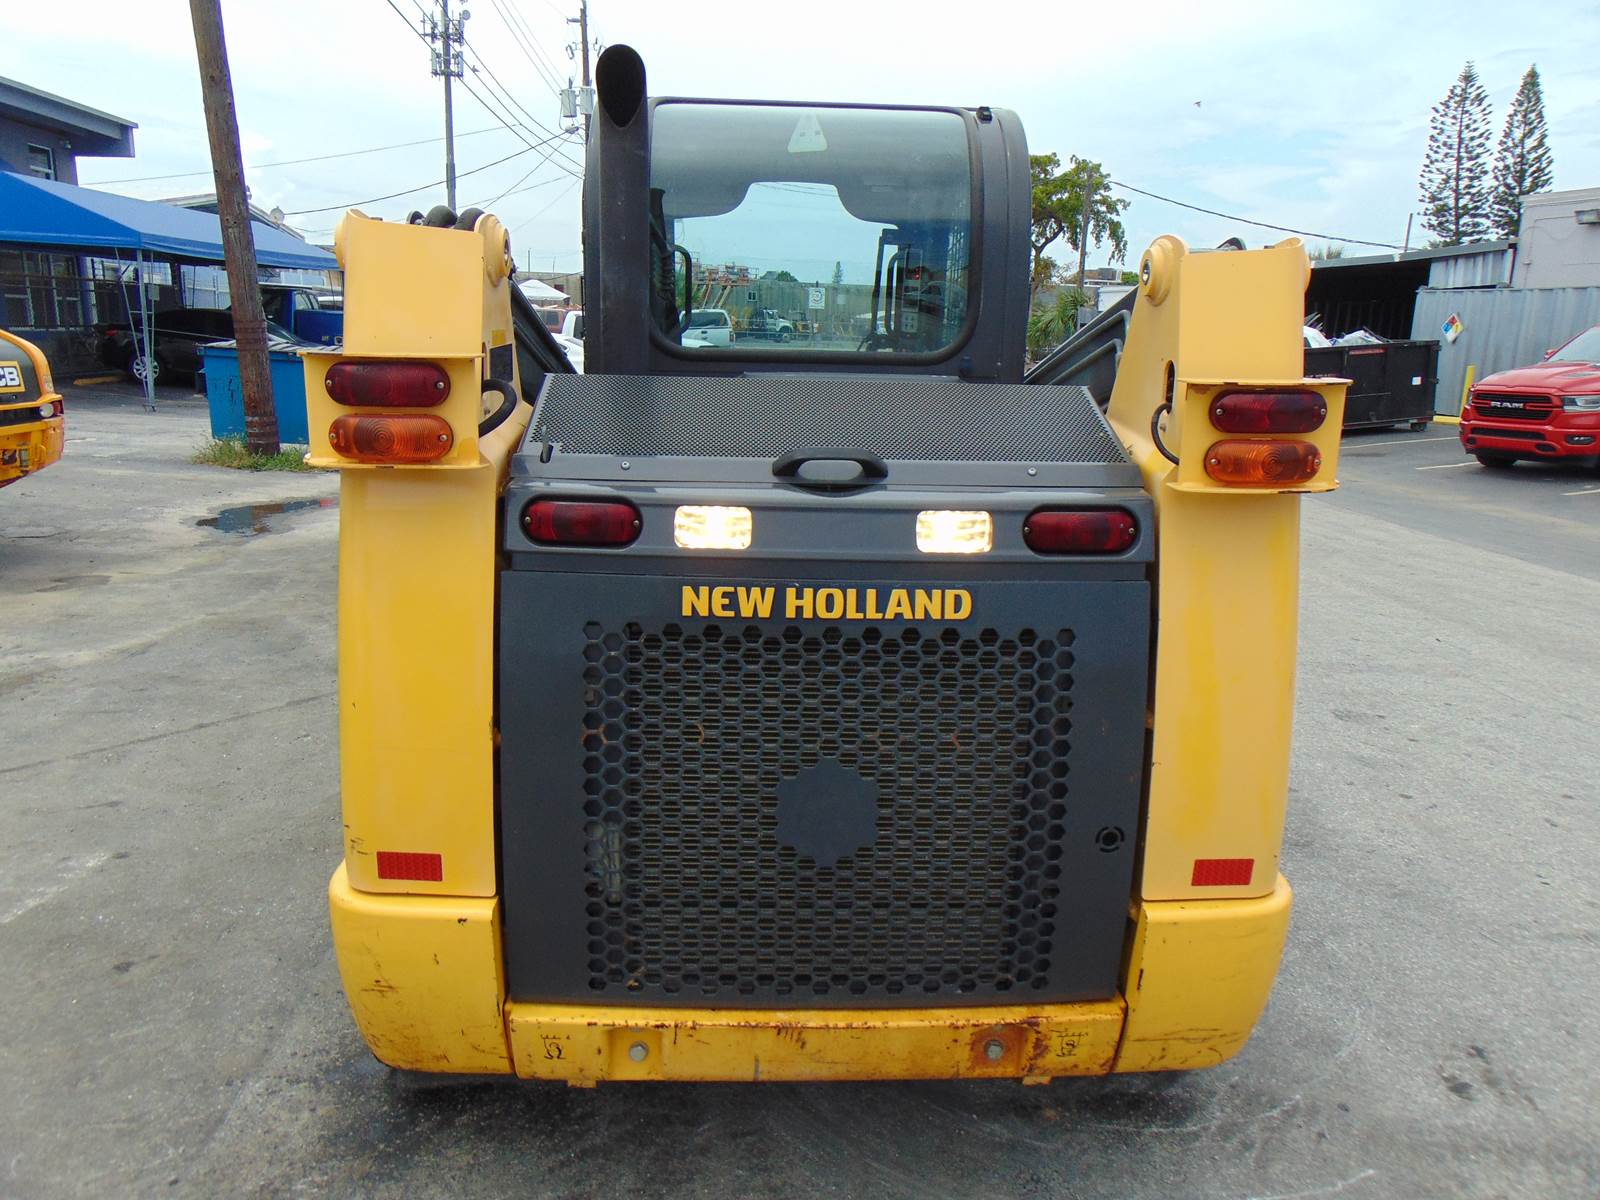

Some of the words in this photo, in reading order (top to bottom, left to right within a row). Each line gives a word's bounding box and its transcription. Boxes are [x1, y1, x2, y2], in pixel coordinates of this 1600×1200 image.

[1490, 401, 1524, 409] RAM
[681, 585, 775, 618] NEW
[785, 587, 972, 620] HOLLAND
